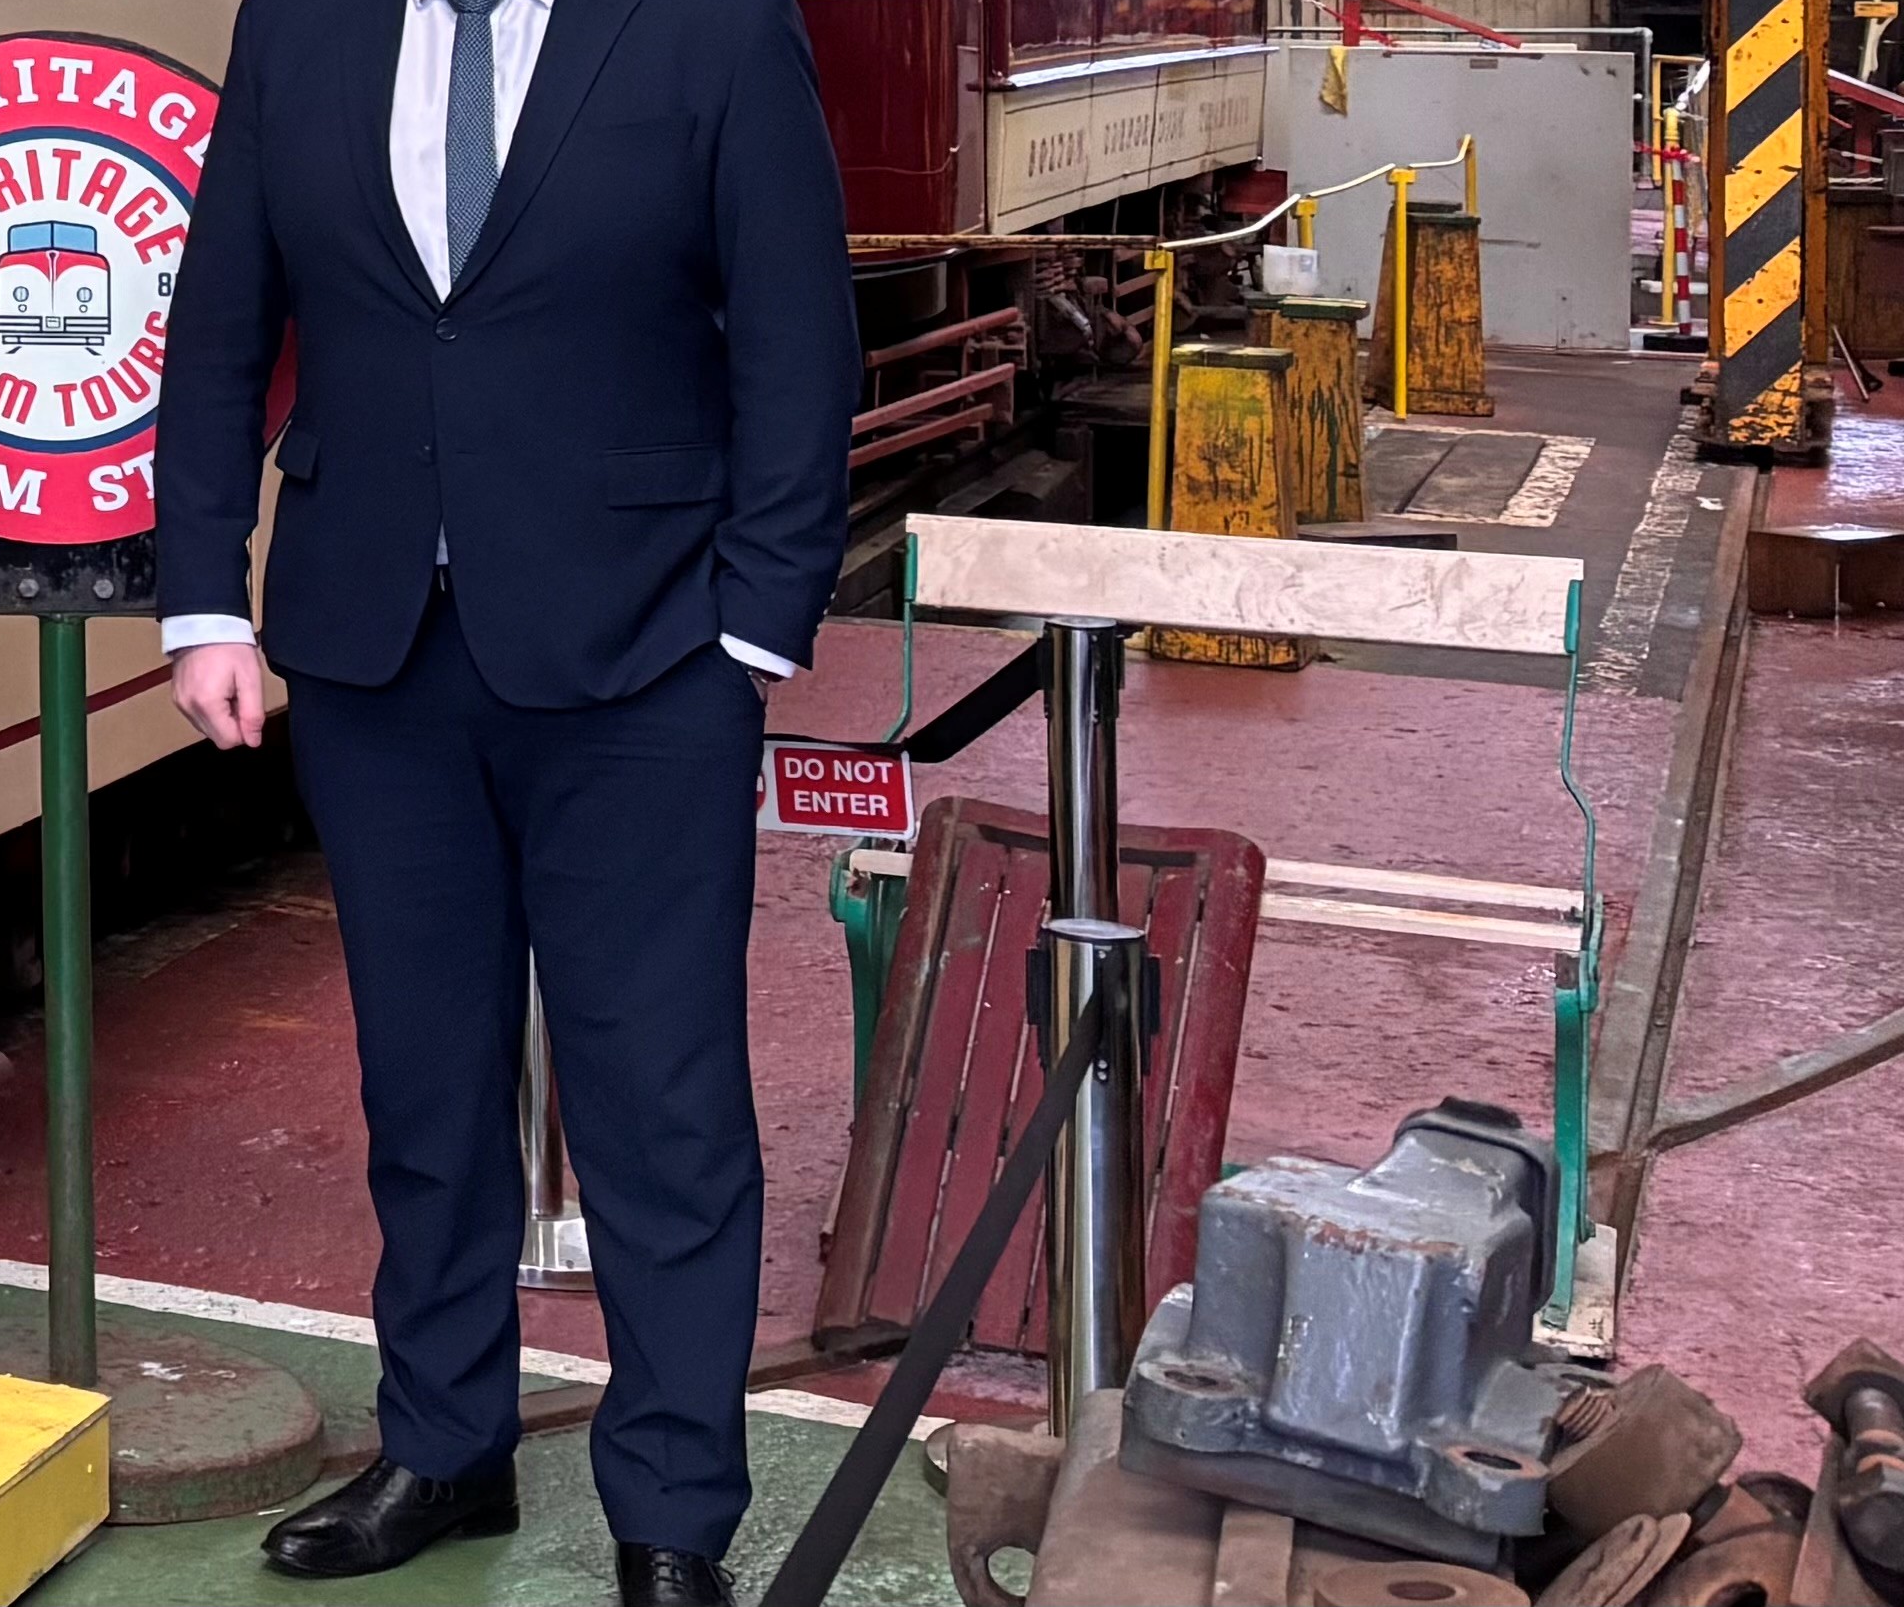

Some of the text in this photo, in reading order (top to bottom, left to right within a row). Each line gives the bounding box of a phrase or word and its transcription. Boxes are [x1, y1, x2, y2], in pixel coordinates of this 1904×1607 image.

[158, 271, 174, 297] 8
[88, 450, 155, 513] ST
[784, 757, 894, 784] DO NOT
[793, 789, 889, 817] ENTER
